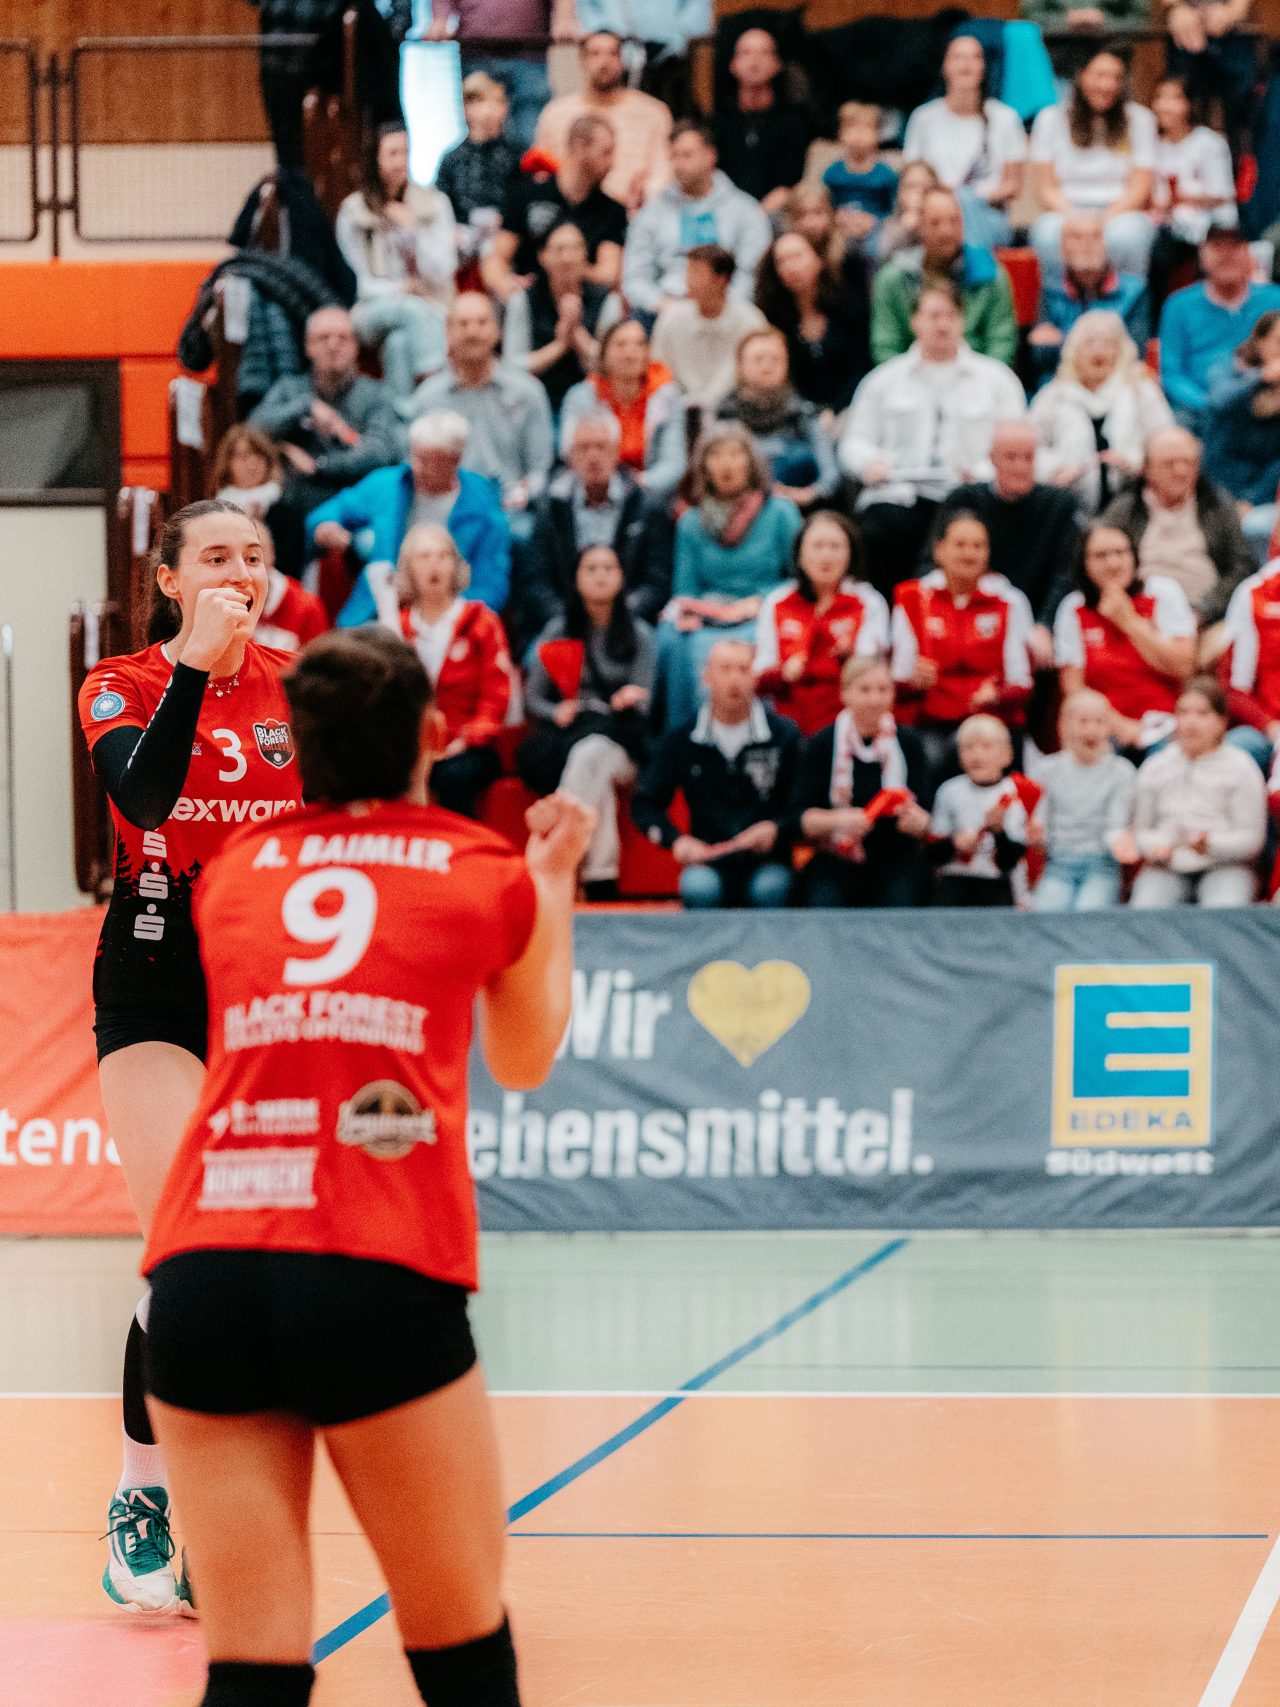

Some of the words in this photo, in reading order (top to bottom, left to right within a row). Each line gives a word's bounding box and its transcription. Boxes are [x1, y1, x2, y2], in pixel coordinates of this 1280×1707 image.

[256, 727, 287, 739] BLACK
[259, 735, 289, 746] FOREST
[212, 728, 248, 783] 3
[253, 838, 289, 870] A.
[298, 834, 454, 875] BAIMLER
[281, 866, 378, 986] 9
[0, 1107, 121, 1167] ten
[470, 1087, 935, 1180] ebensmittel.
[1070, 1111, 1193, 1132] EDEKA
[1044, 1147, 1215, 1178] Südwest
